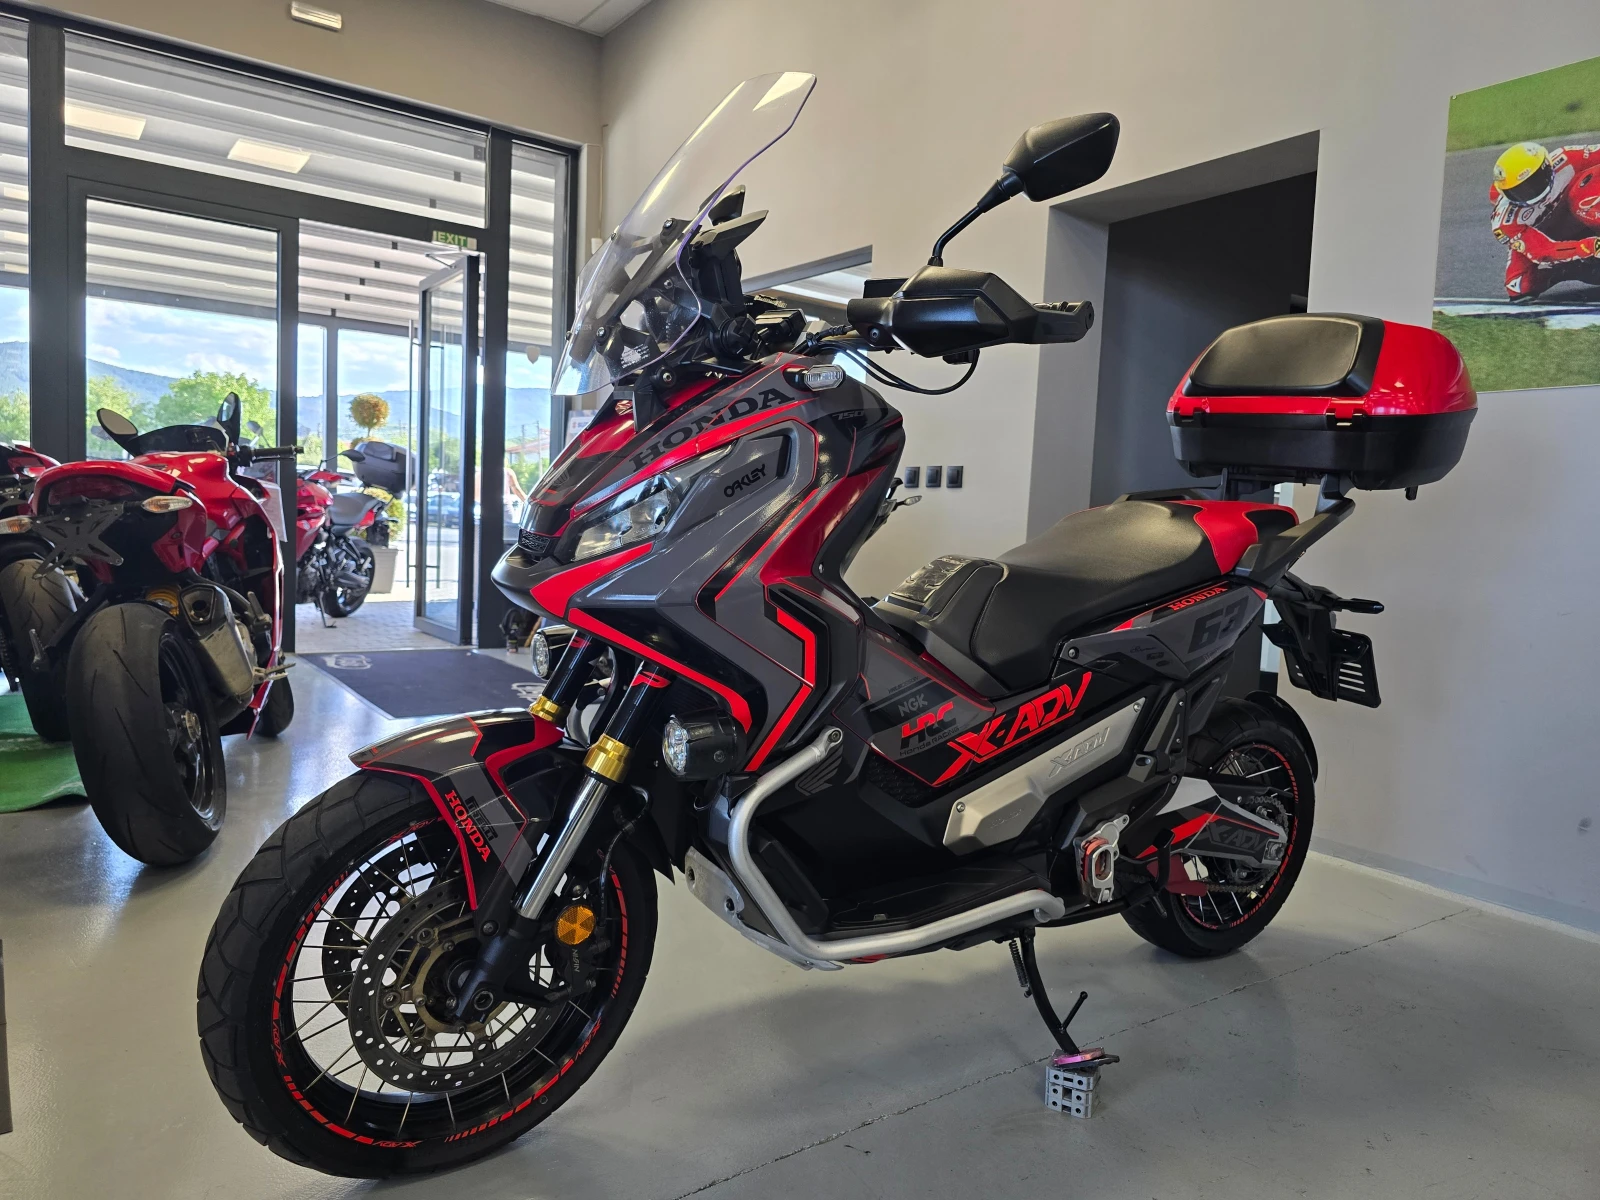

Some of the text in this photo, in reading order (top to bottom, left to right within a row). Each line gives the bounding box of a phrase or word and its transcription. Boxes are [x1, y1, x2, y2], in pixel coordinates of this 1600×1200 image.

[437, 231, 467, 247] EXIT
[628, 387, 796, 473] HONDA
[831, 409, 865, 421] 750
[723, 463, 767, 498] OAKLEY
[1167, 586, 1229, 612] HONDA
[1187, 595, 1250, 655] 63
[897, 693, 928, 717] NGK
[900, 701, 957, 750] HRC
[932, 671, 1093, 786] X-ADV
[444, 790, 491, 863] HONDA
[1198, 820, 1267, 853] X-ADV
